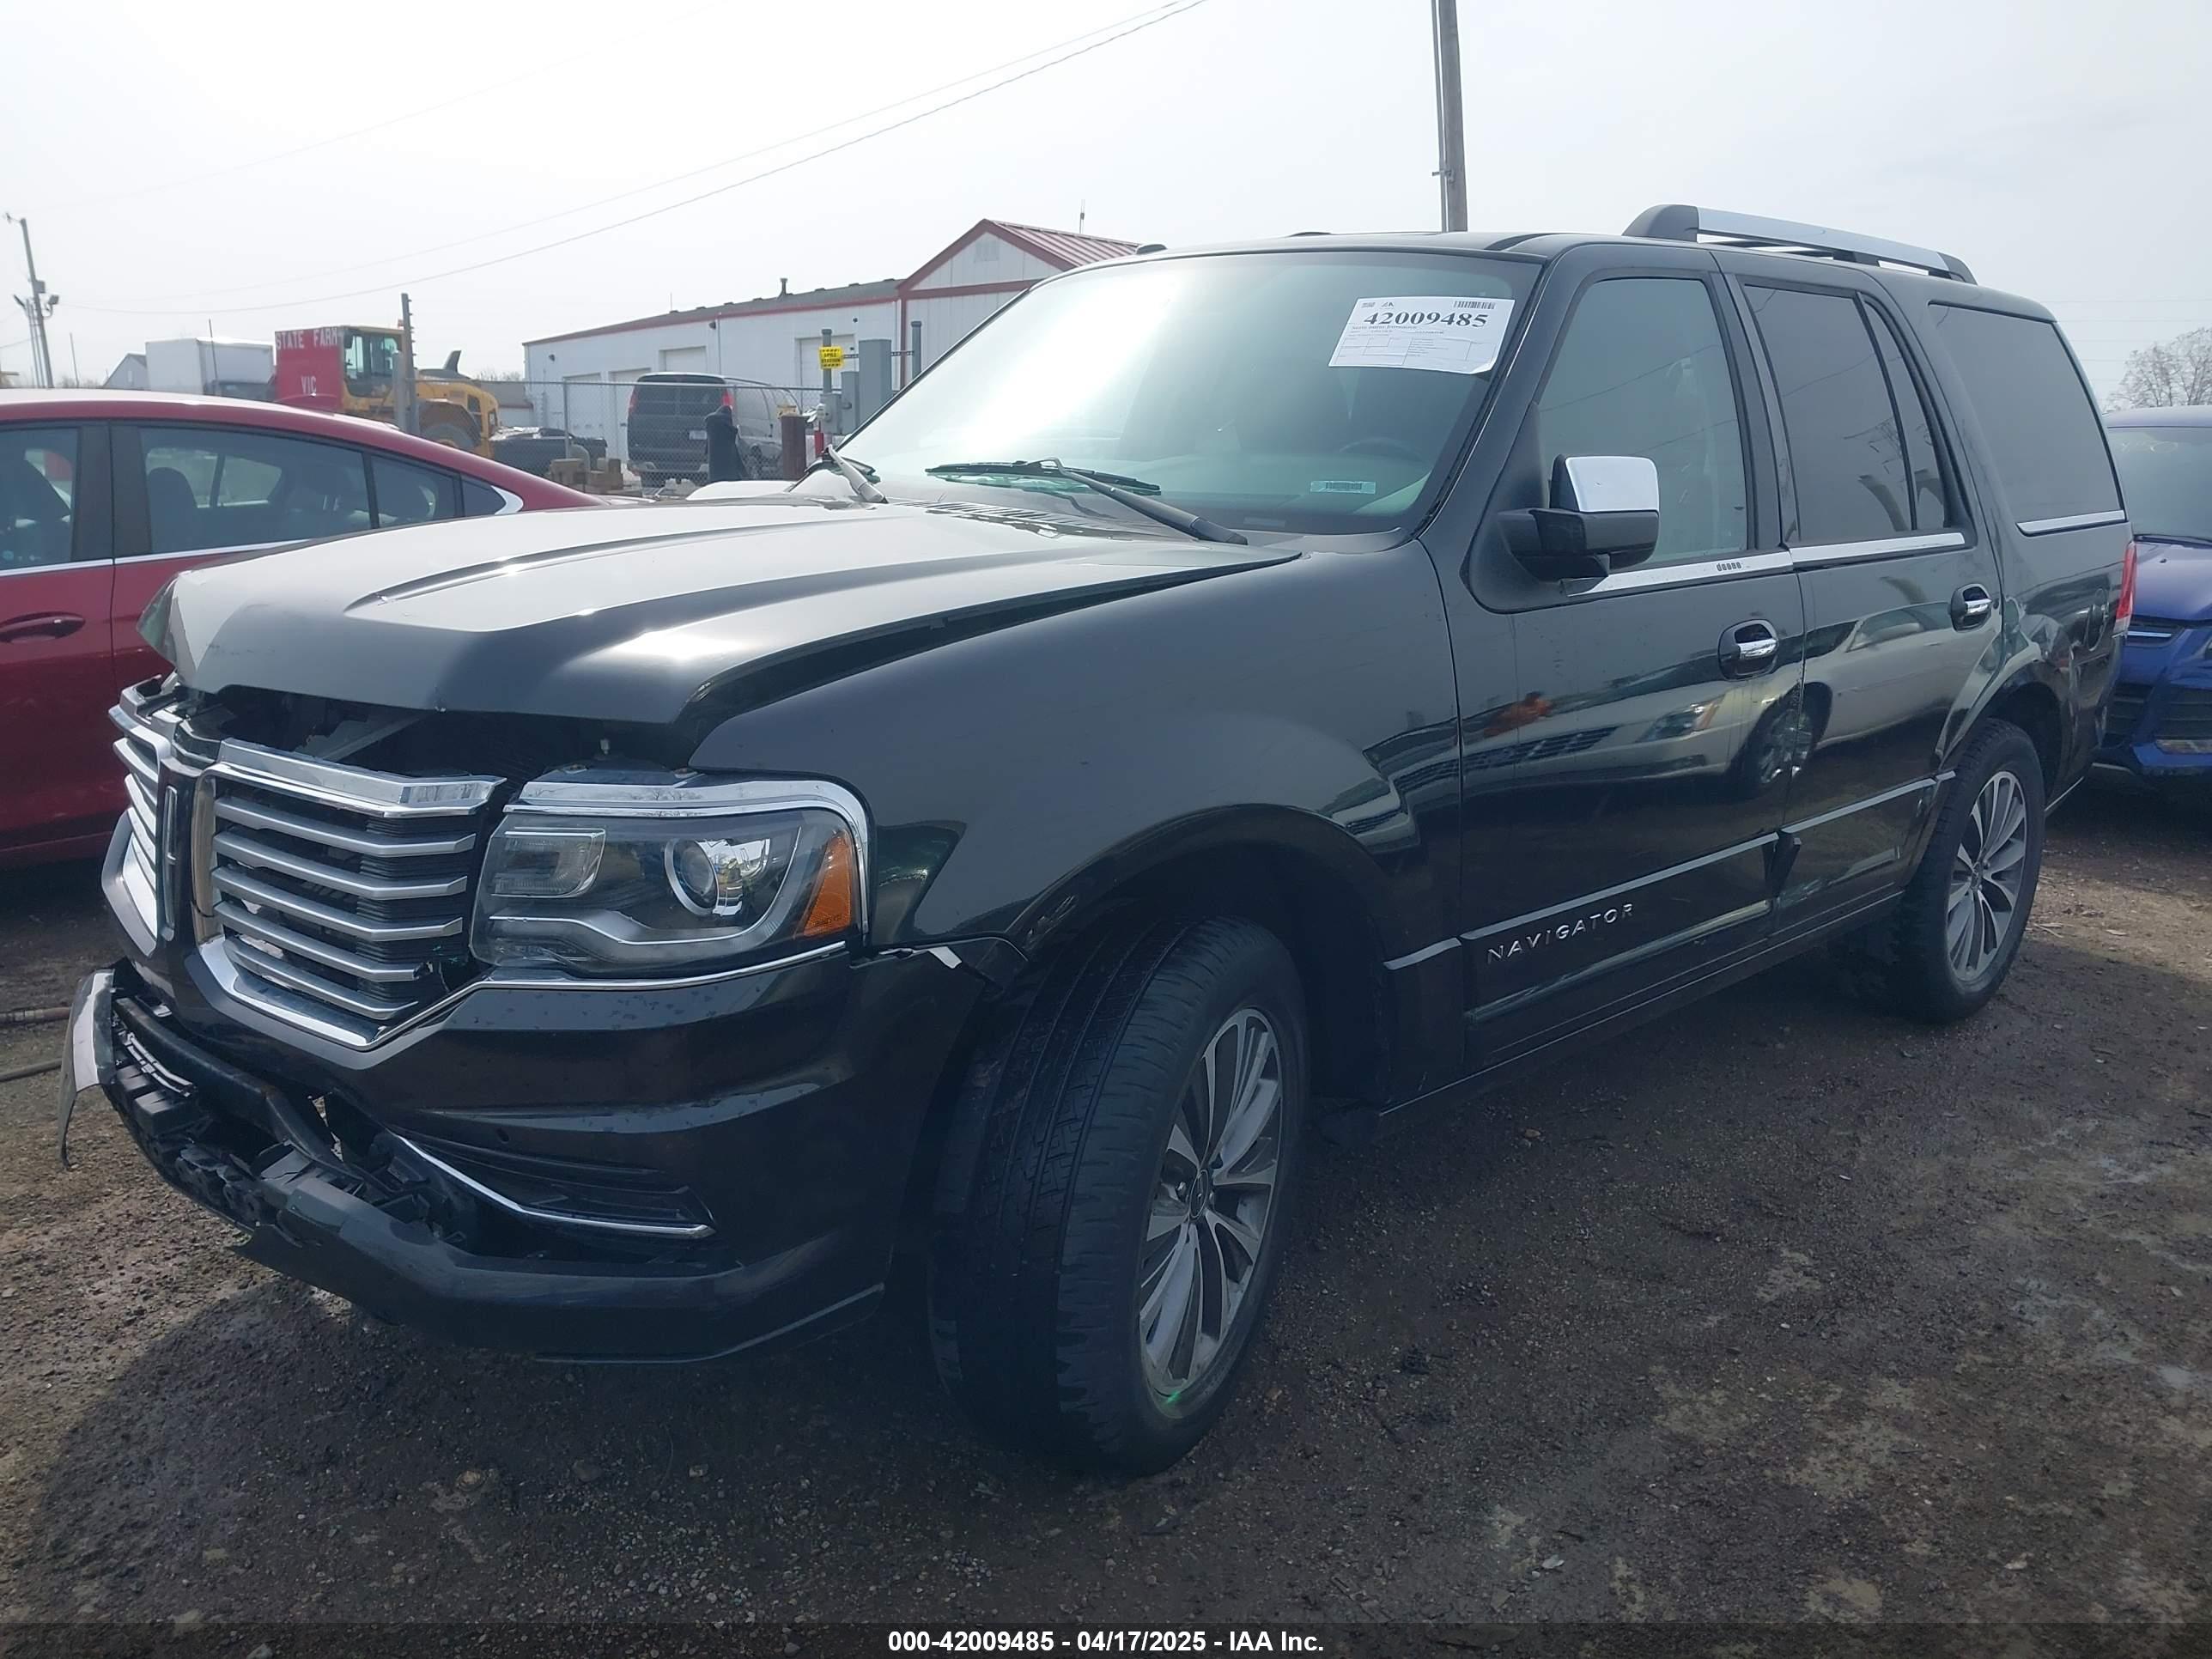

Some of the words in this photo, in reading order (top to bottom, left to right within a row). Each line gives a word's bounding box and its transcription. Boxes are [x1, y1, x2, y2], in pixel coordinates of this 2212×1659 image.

[1364, 311, 1489, 328] 42009485
[276, 331, 304, 349] STATE
[313, 327, 337, 347] FARM
[1486, 902, 1634, 964] NAVIGATOR
